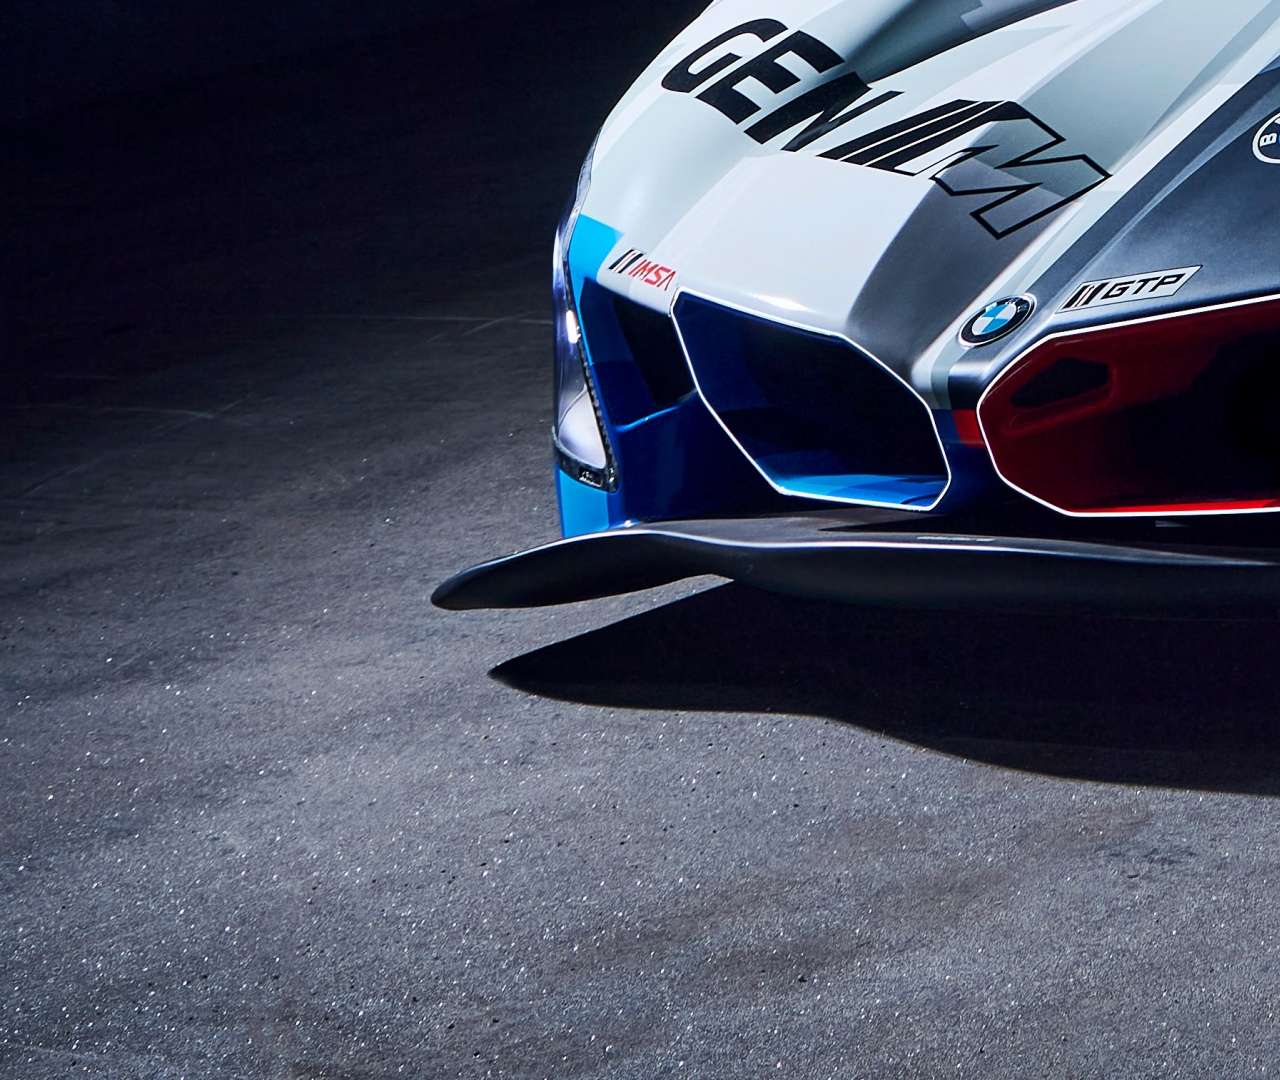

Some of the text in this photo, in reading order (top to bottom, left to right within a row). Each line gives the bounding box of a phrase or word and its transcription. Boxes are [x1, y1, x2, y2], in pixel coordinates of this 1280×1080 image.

[660, 18, 904, 152] GEN
[628, 259, 676, 291] IMSA
[1100, 273, 1187, 300] GTP
